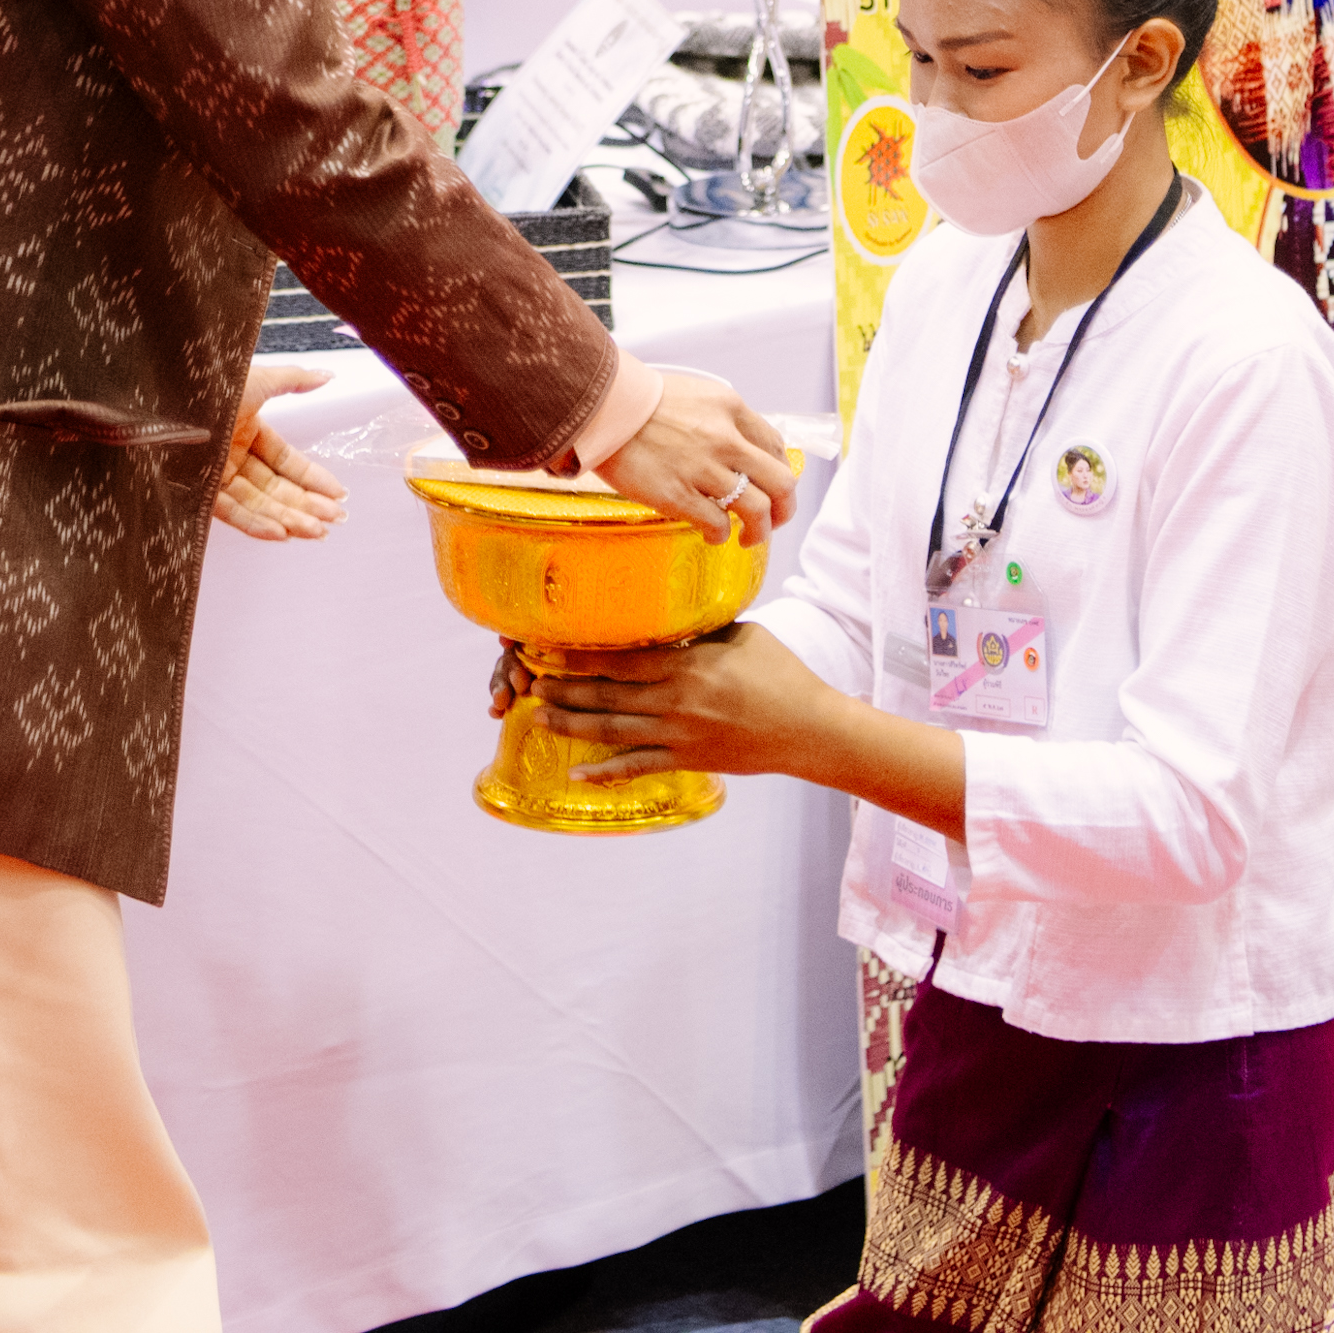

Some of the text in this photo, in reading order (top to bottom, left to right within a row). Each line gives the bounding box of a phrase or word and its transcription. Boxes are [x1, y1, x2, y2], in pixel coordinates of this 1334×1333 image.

[895, 873, 953, 912] ผู้ประกอบการ
